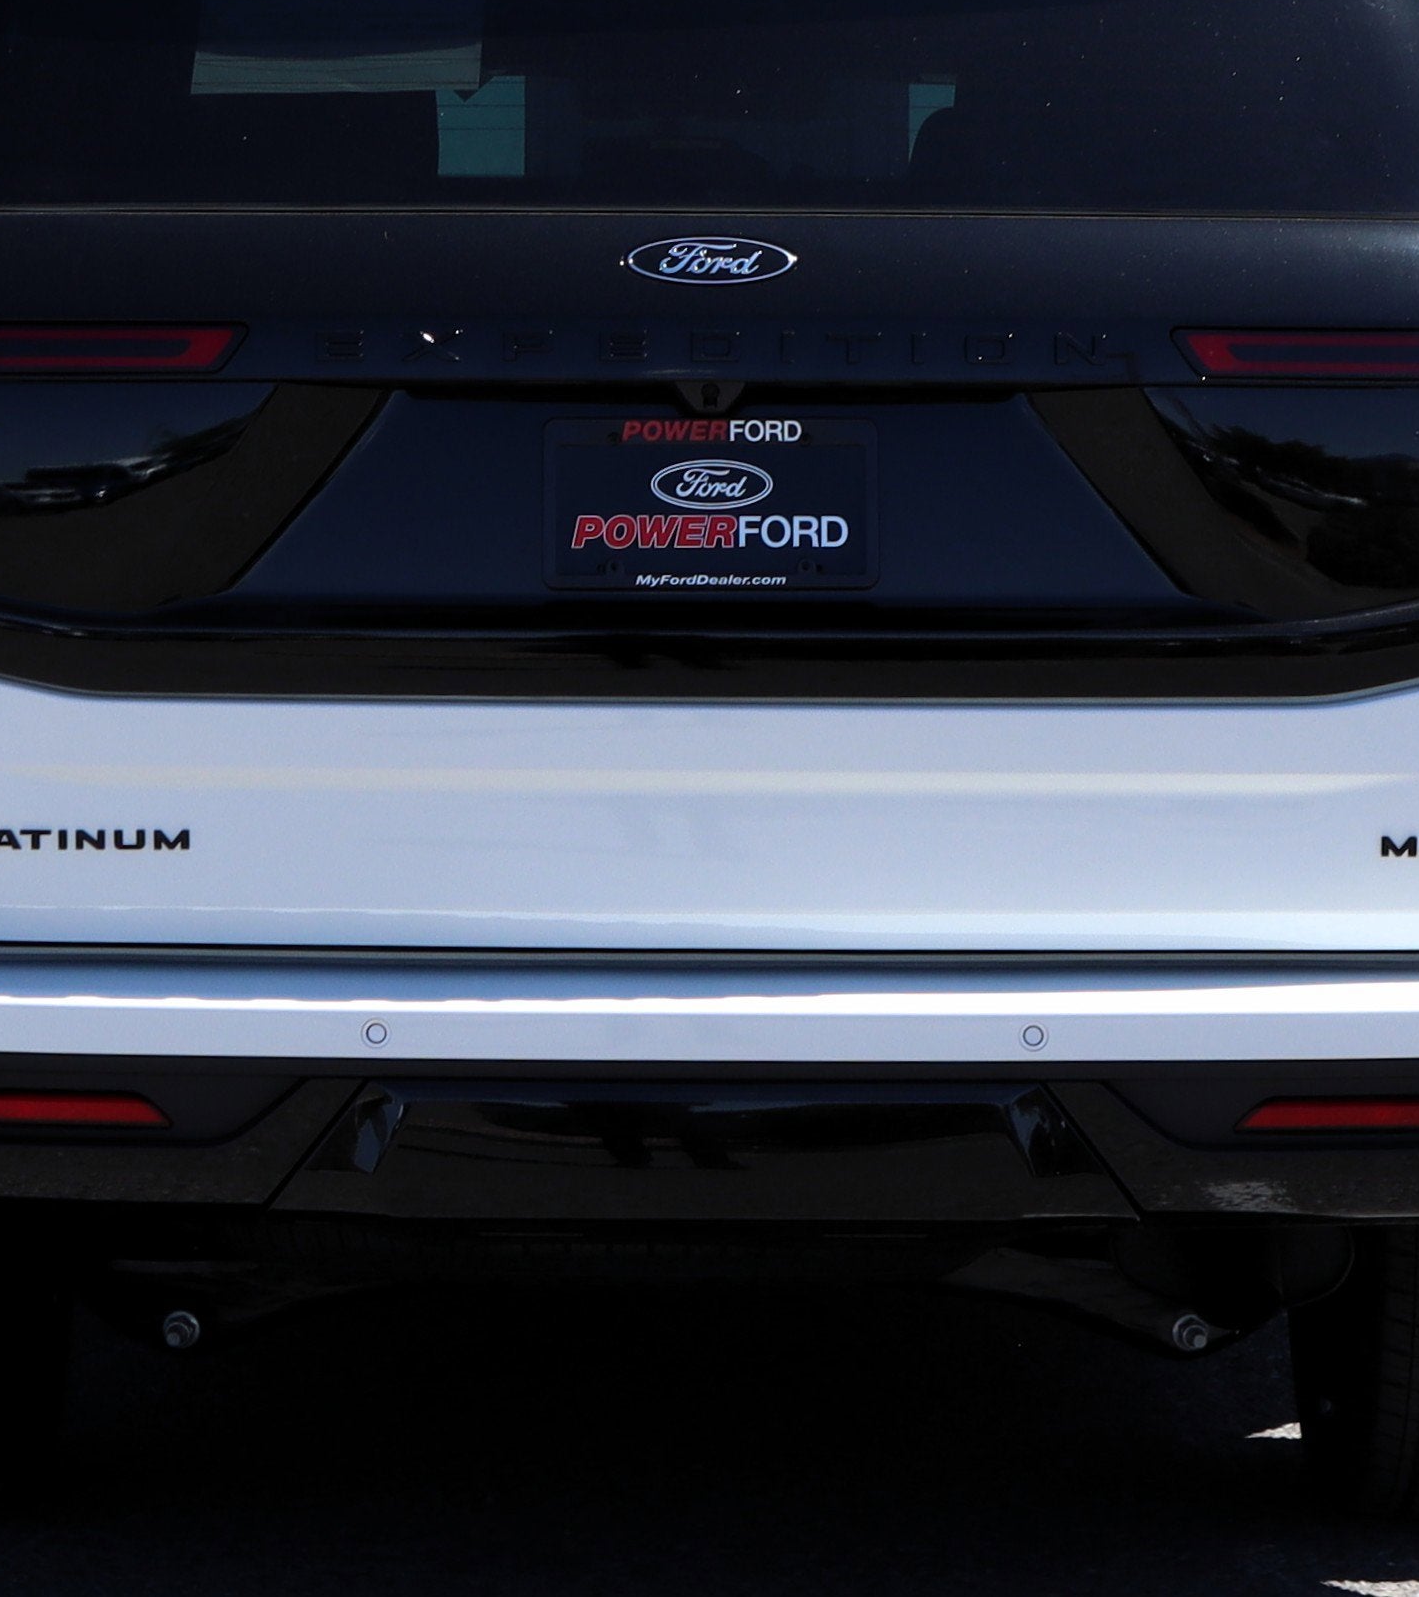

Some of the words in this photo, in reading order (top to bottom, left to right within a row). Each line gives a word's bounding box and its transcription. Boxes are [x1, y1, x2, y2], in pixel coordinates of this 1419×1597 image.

[658, 241, 763, 276] Ford
[675, 467, 749, 499] Ford
[634, 573, 787, 588] MyFordDealer.com
